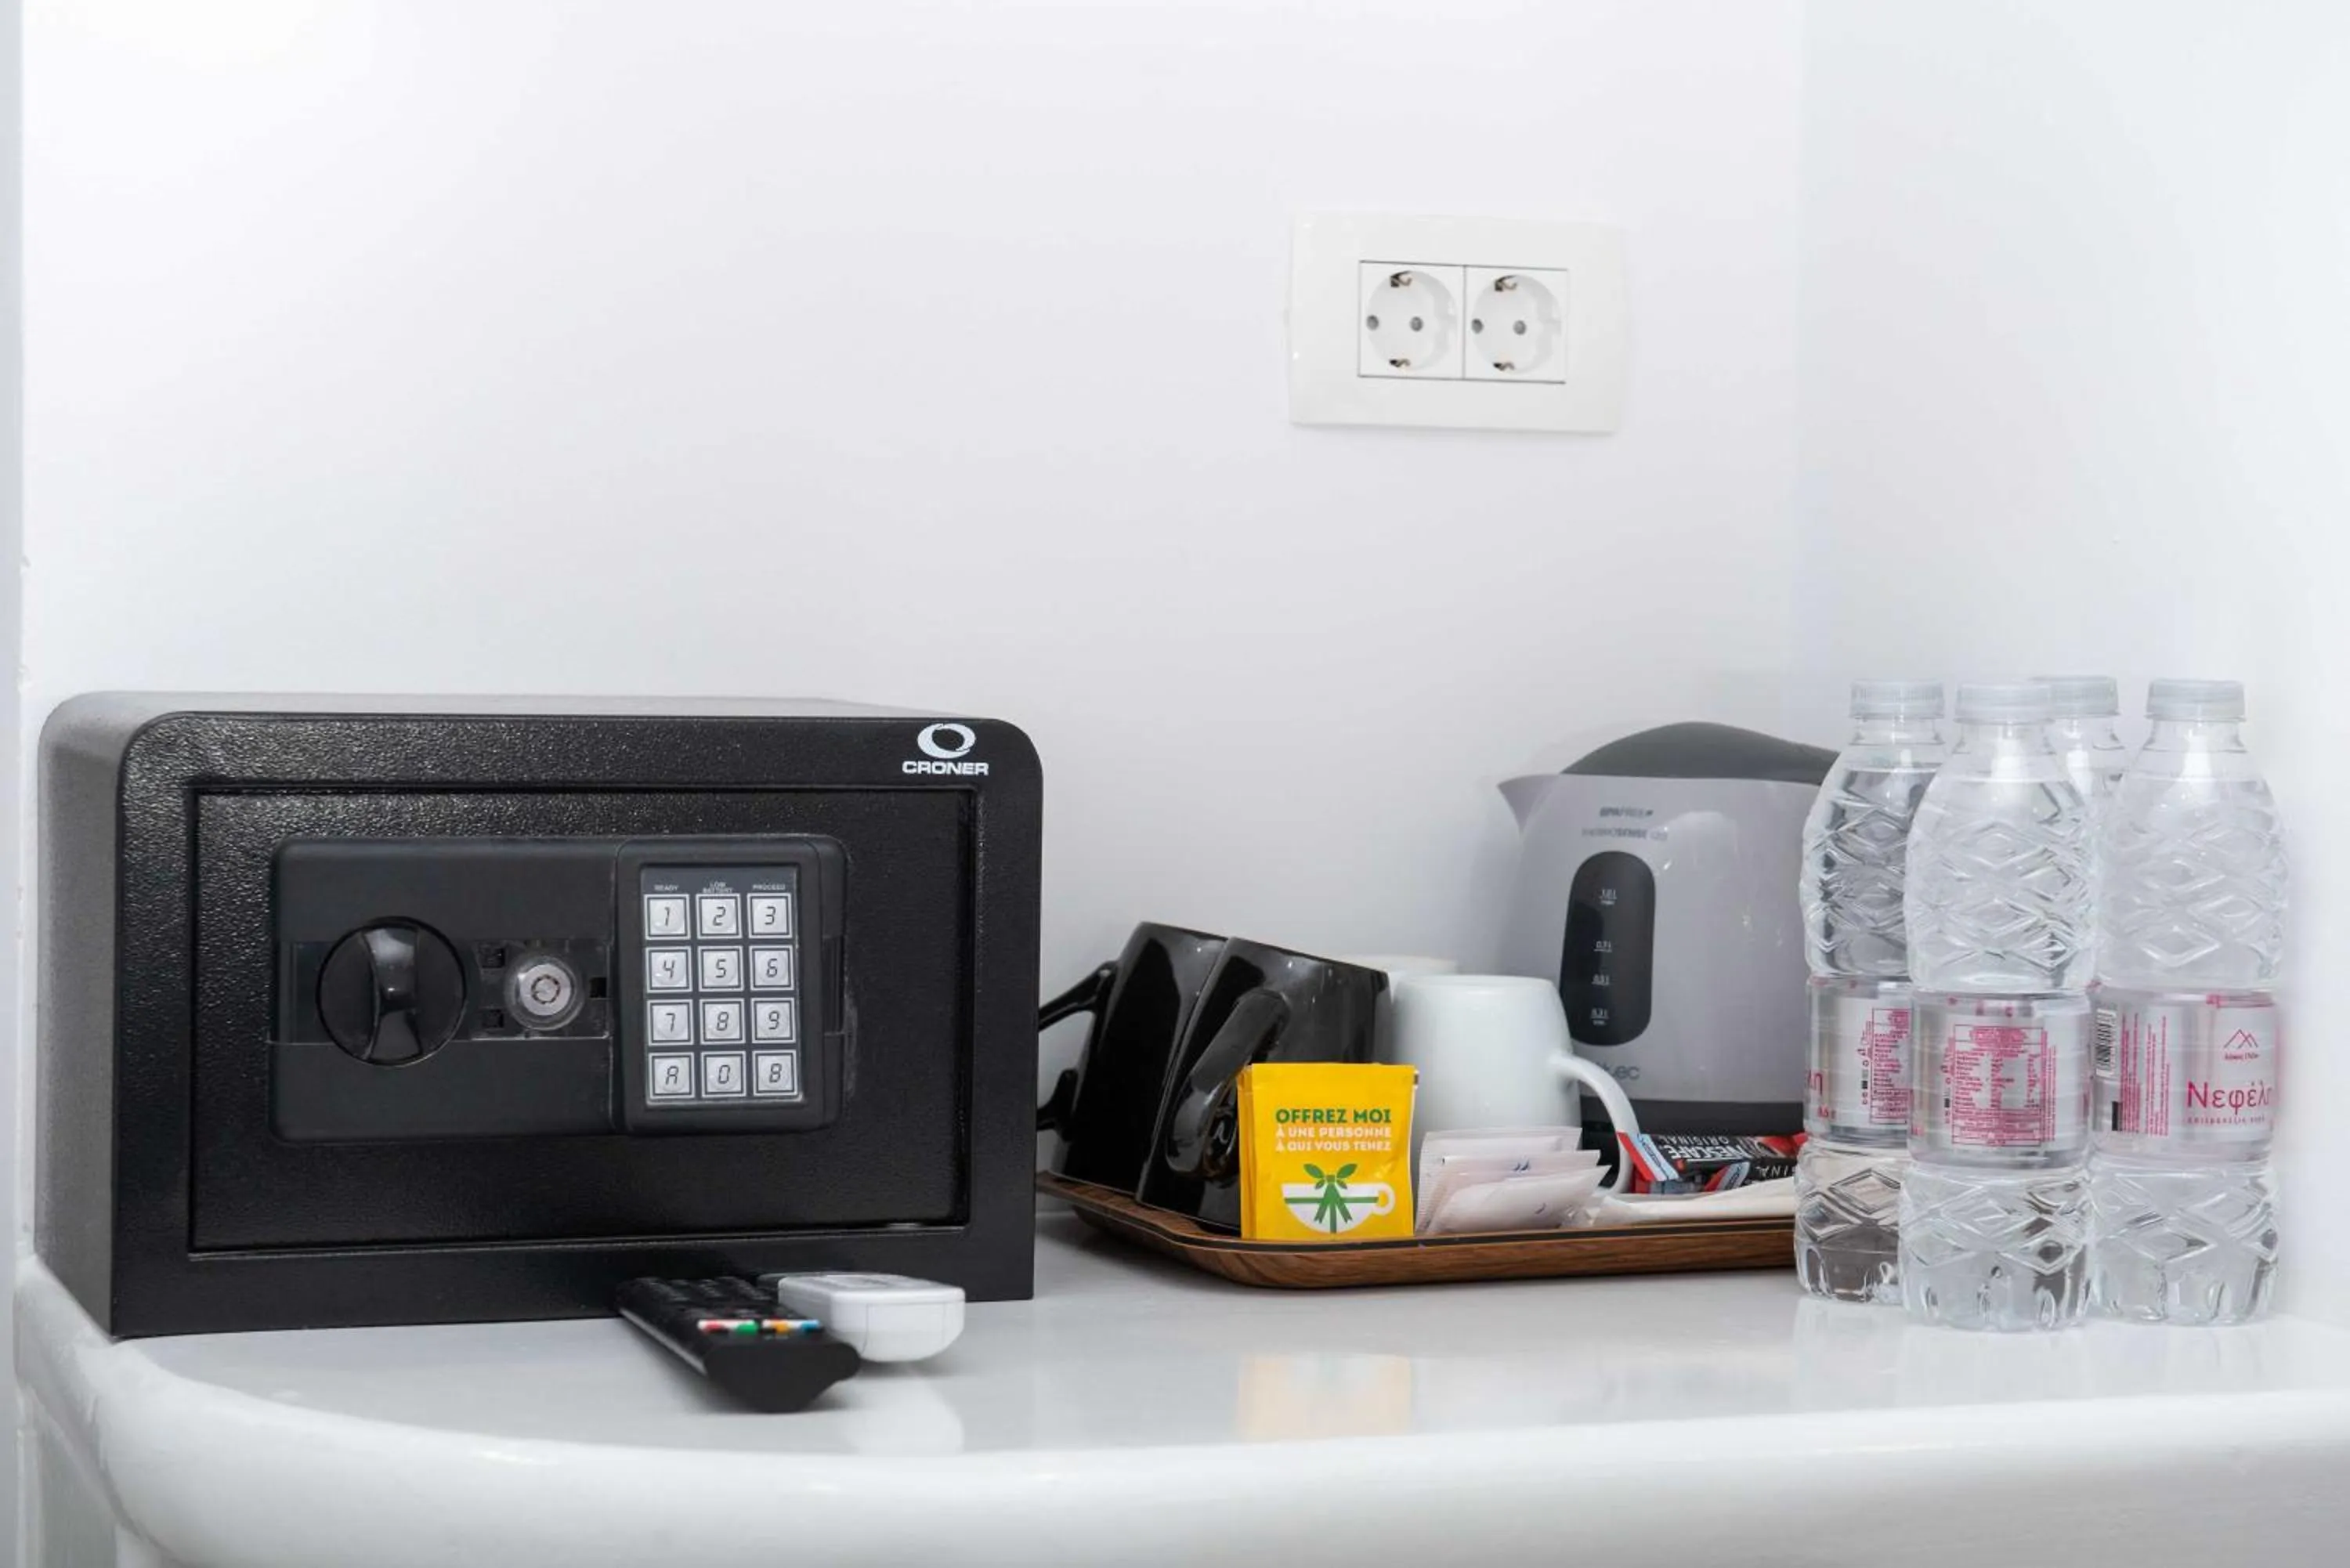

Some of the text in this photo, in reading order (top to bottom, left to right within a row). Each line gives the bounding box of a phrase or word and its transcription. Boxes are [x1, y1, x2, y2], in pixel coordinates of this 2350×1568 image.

[902, 761, 989, 775] CRONER
[712, 906, 726, 926] 2
[764, 906, 776, 925] 3
[663, 959, 675, 978] 4
[715, 959, 727, 978] 5
[765, 958, 778, 977] 6
[666, 1013, 676, 1032] 7
[716, 1011, 729, 1031] 8
[768, 1010, 780, 1030] 9
[665, 1065, 679, 1085] A
[718, 1064, 730, 1084] 0
[1275, 1108, 1392, 1124] OFFREZ MOI
[1275, 1124, 1391, 1138] À UNE PERSONNE
[1275, 1138, 1391, 1151] À QUI VOUS TENEZ
[1659, 1135, 1729, 1147] ORIGINAL
